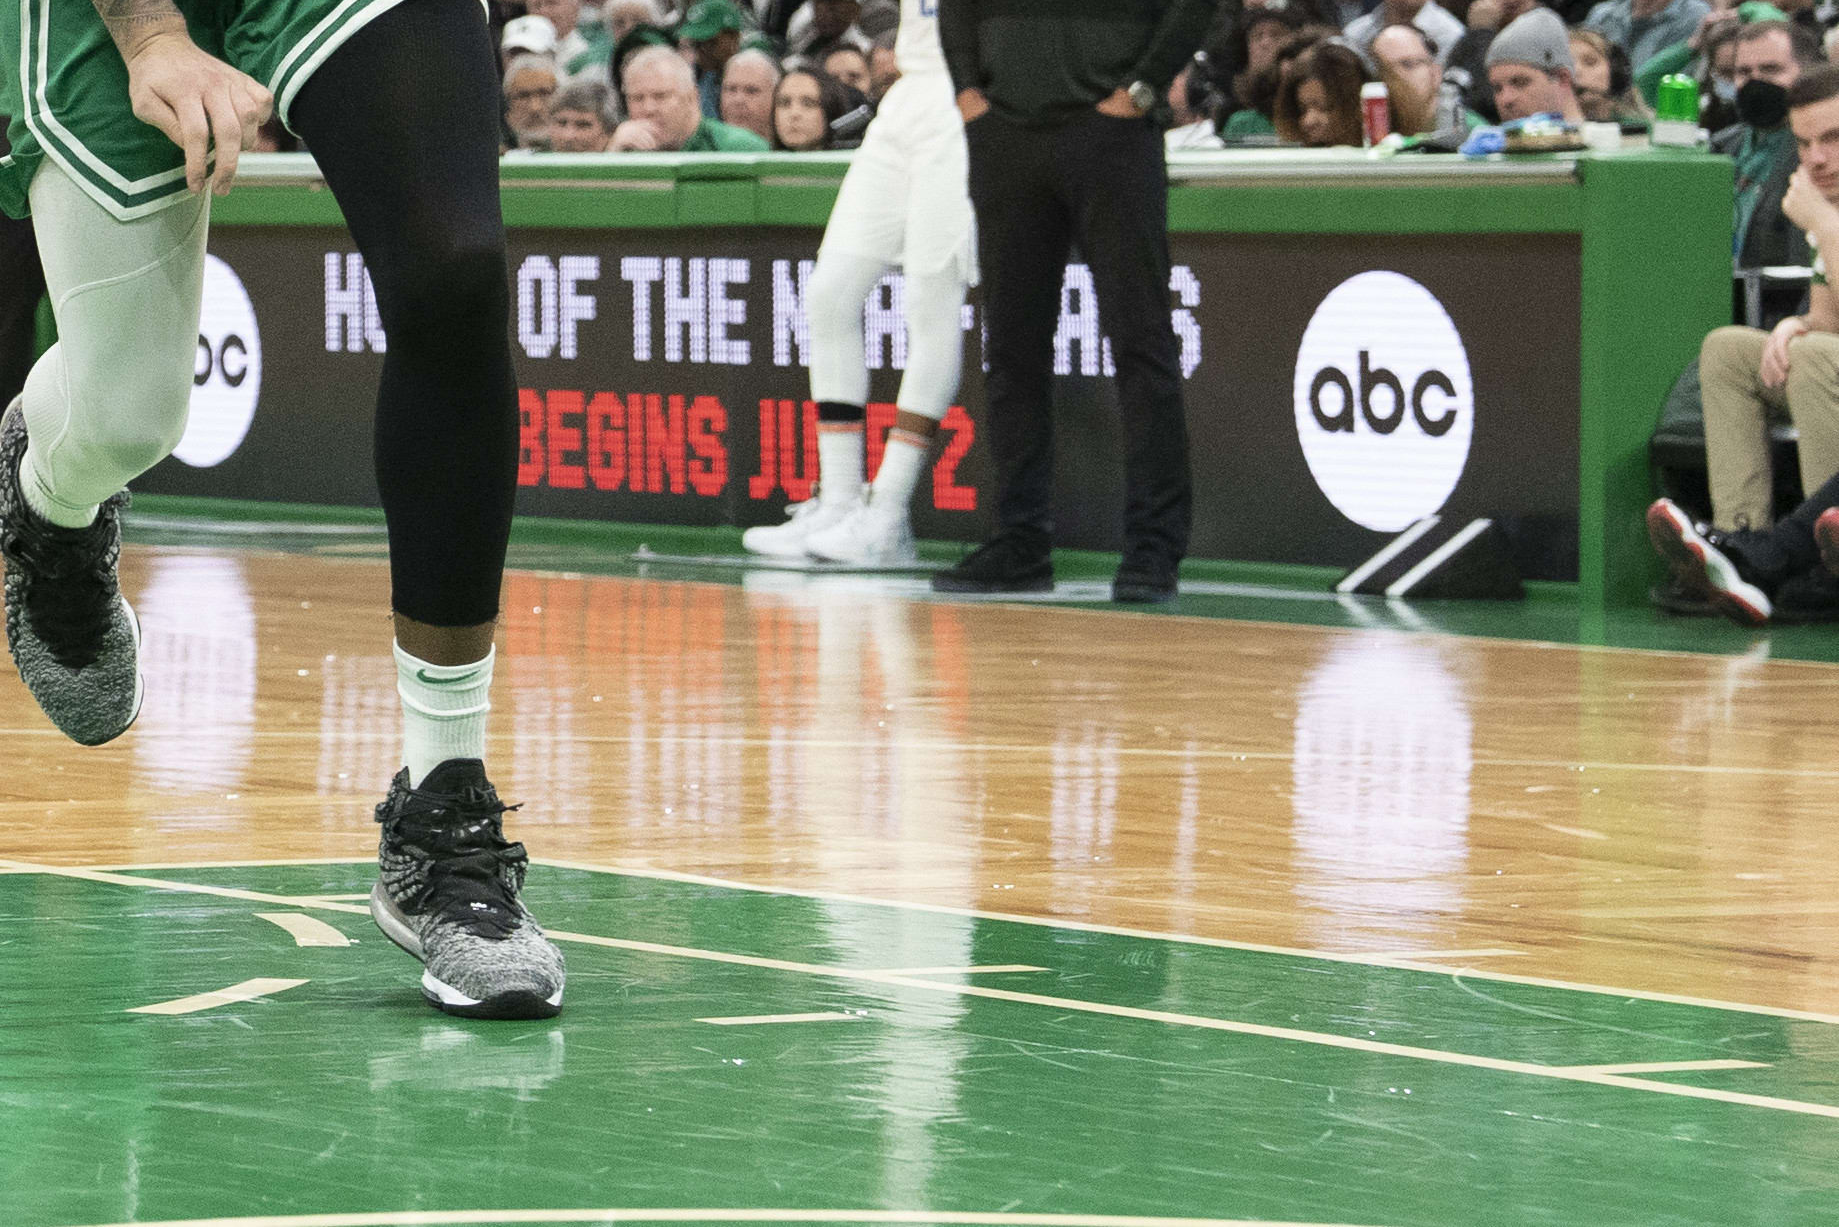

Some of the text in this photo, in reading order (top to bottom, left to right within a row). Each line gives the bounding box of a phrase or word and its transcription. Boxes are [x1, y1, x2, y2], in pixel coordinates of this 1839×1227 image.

[517, 254, 601, 360] OF
[620, 256, 752, 366] THE
[772, 259, 909, 371] NA
[518, 387, 978, 511] BEGINS JU 2
[1308, 349, 1459, 438] abc
